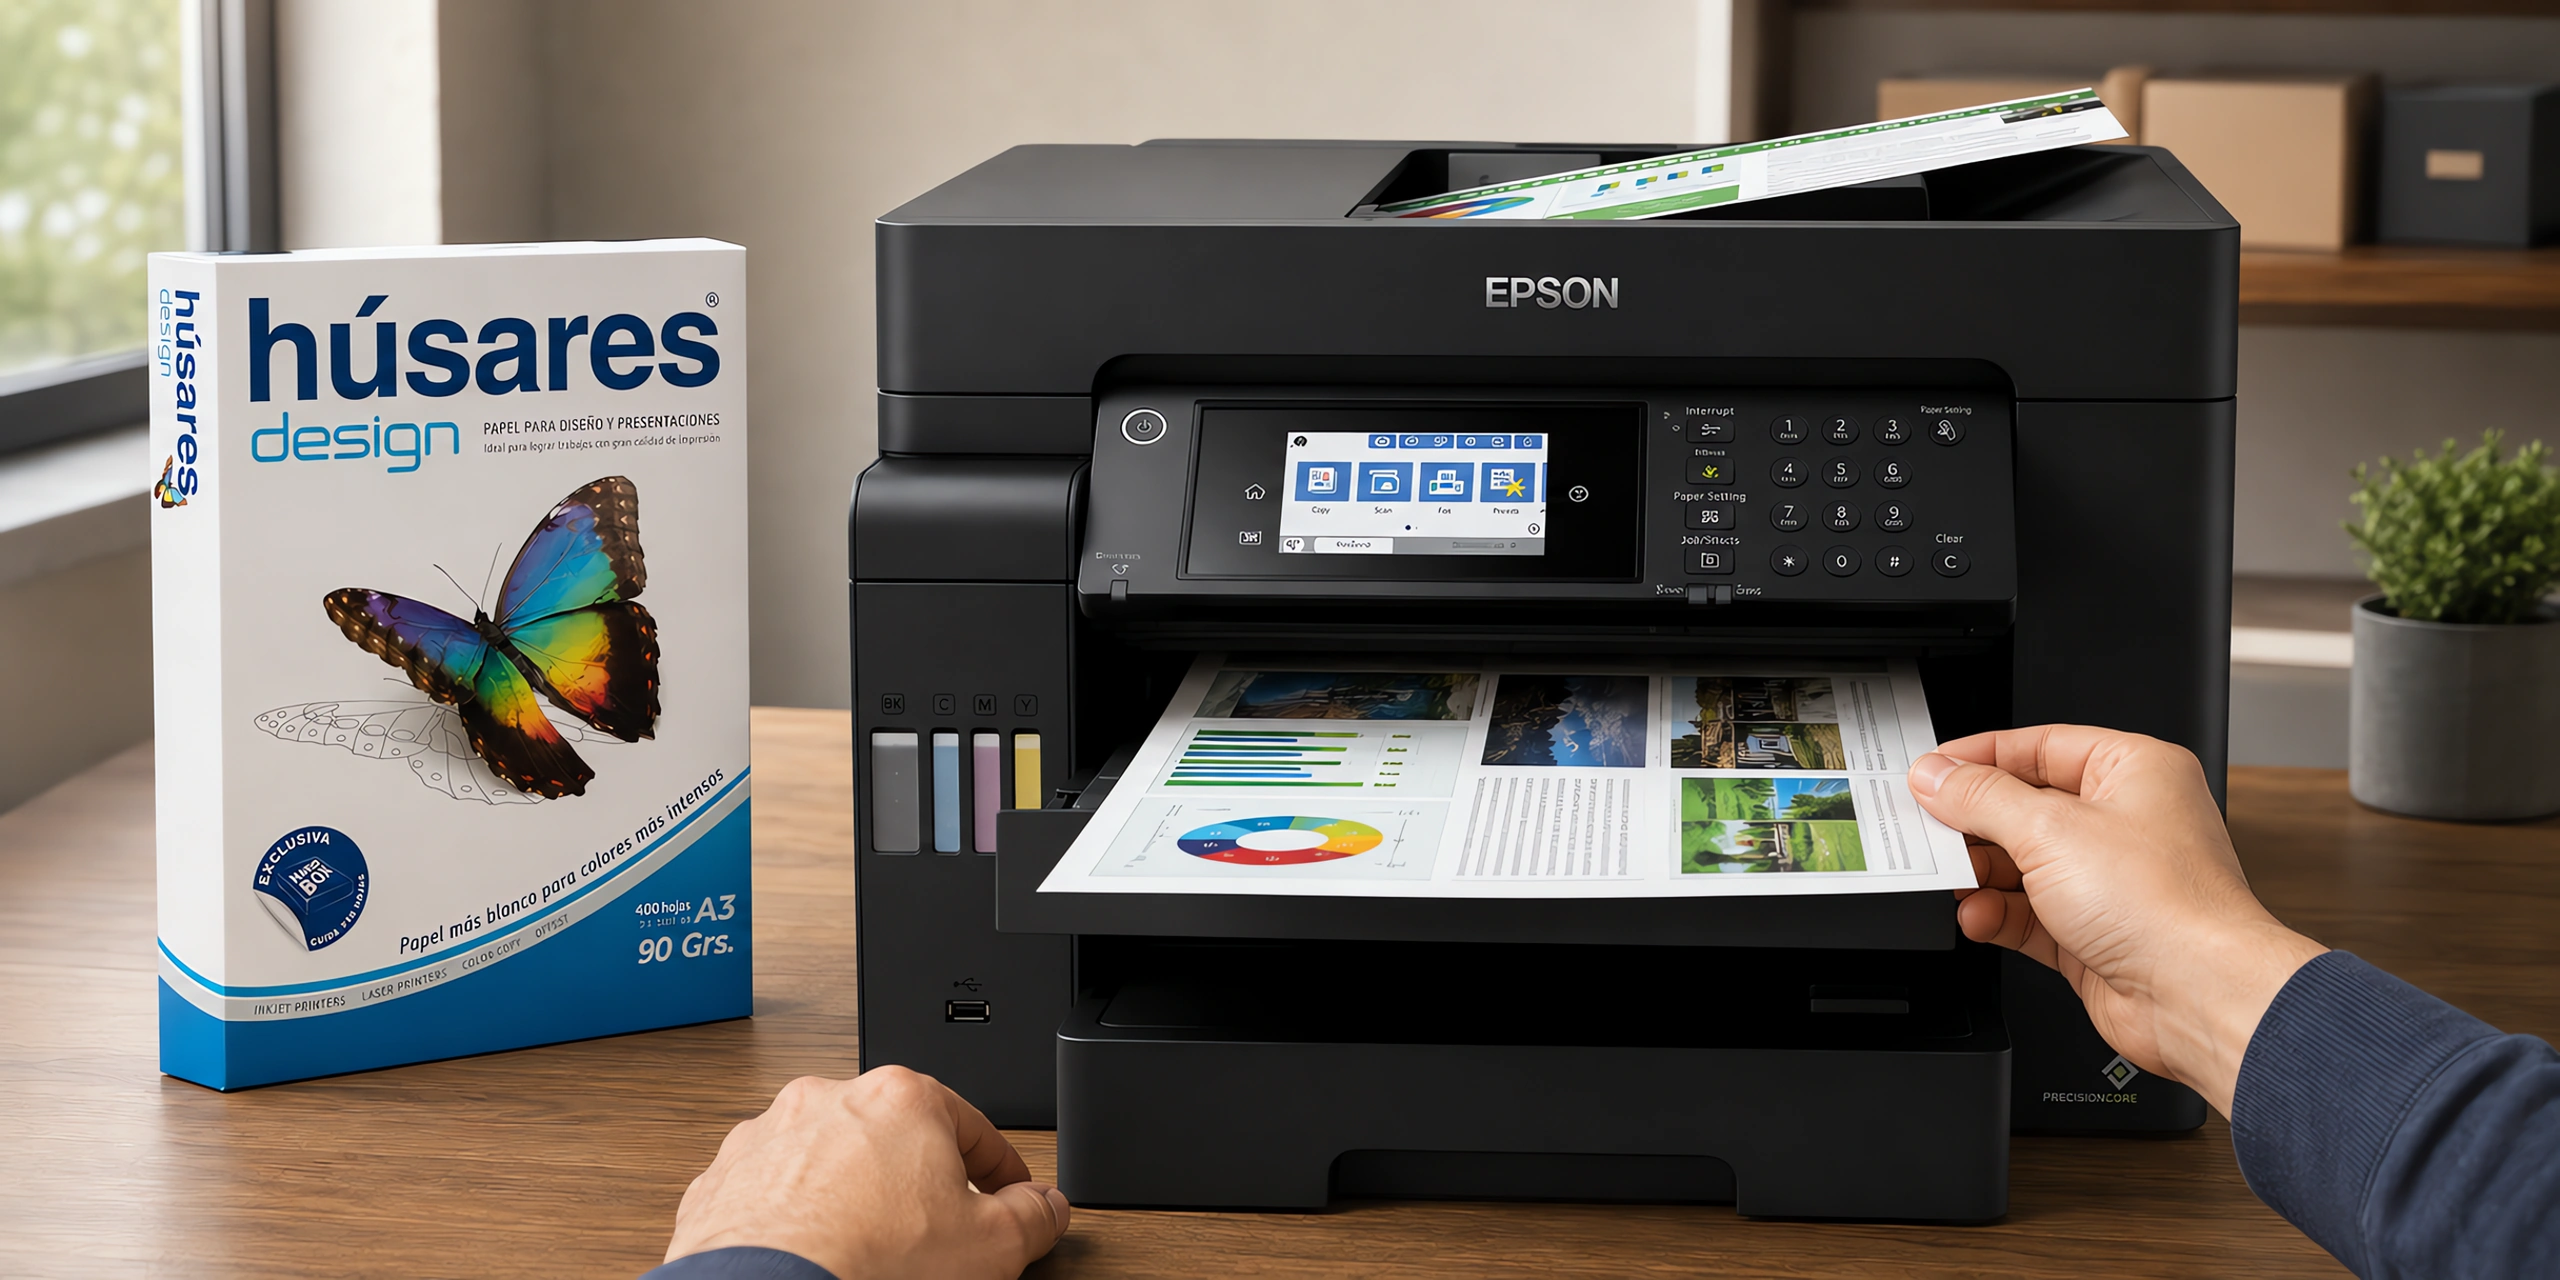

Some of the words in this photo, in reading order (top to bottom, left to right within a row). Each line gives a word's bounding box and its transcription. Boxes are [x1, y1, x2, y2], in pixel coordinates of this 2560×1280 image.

[1486, 276, 1619, 309] EPSON
[157, 288, 173, 378] design
[247, 294, 721, 402] húsares
[175, 289, 202, 496] húsares
[1685, 406, 1735, 417] Interrupt
[483, 421, 520, 435] PAPEL
[524, 420, 556, 433] PARA
[559, 415, 603, 432] DISEÑO
[607, 417, 615, 430] Y
[617, 413, 720, 429] PRESENTACIONES
[1785, 419, 1792, 431] 1
[1836, 418, 1846, 432] 2
[1888, 419, 1898, 432] 3
[251, 411, 460, 473] design
[1836, 462, 1846, 475] 5
[1887, 462, 1898, 475] 6
[1673, 491, 1705, 502] Paper
[1783, 505, 1795, 518] 7
[1836, 505, 1847, 518] 8
[1888, 505, 1899, 519] 9
[1944, 555, 1957, 569] C
[883, 697, 902, 710] BK
[939, 698, 949, 710] C
[978, 699, 992, 711] M
[1021, 699, 1032, 711] Y
[258, 831, 331, 886] EXCLUSIVA
[400, 925, 445, 955] Papel
[449, 914, 482, 939] más
[487, 890, 538, 923] blanco
[541, 871, 577, 903] para
[580, 837, 633, 878] colores
[634, 817, 665, 844] más
[665, 767, 724, 820] intensos
[298, 864, 334, 897] BOX
[635, 902, 660, 916] 400
[661, 899, 691, 915] hojas
[693, 894, 736, 924] A3
[638, 935, 673, 964] 90
[681, 931, 734, 958] Grs.
[2042, 1091, 2138, 1104] PRECISIONCORE
